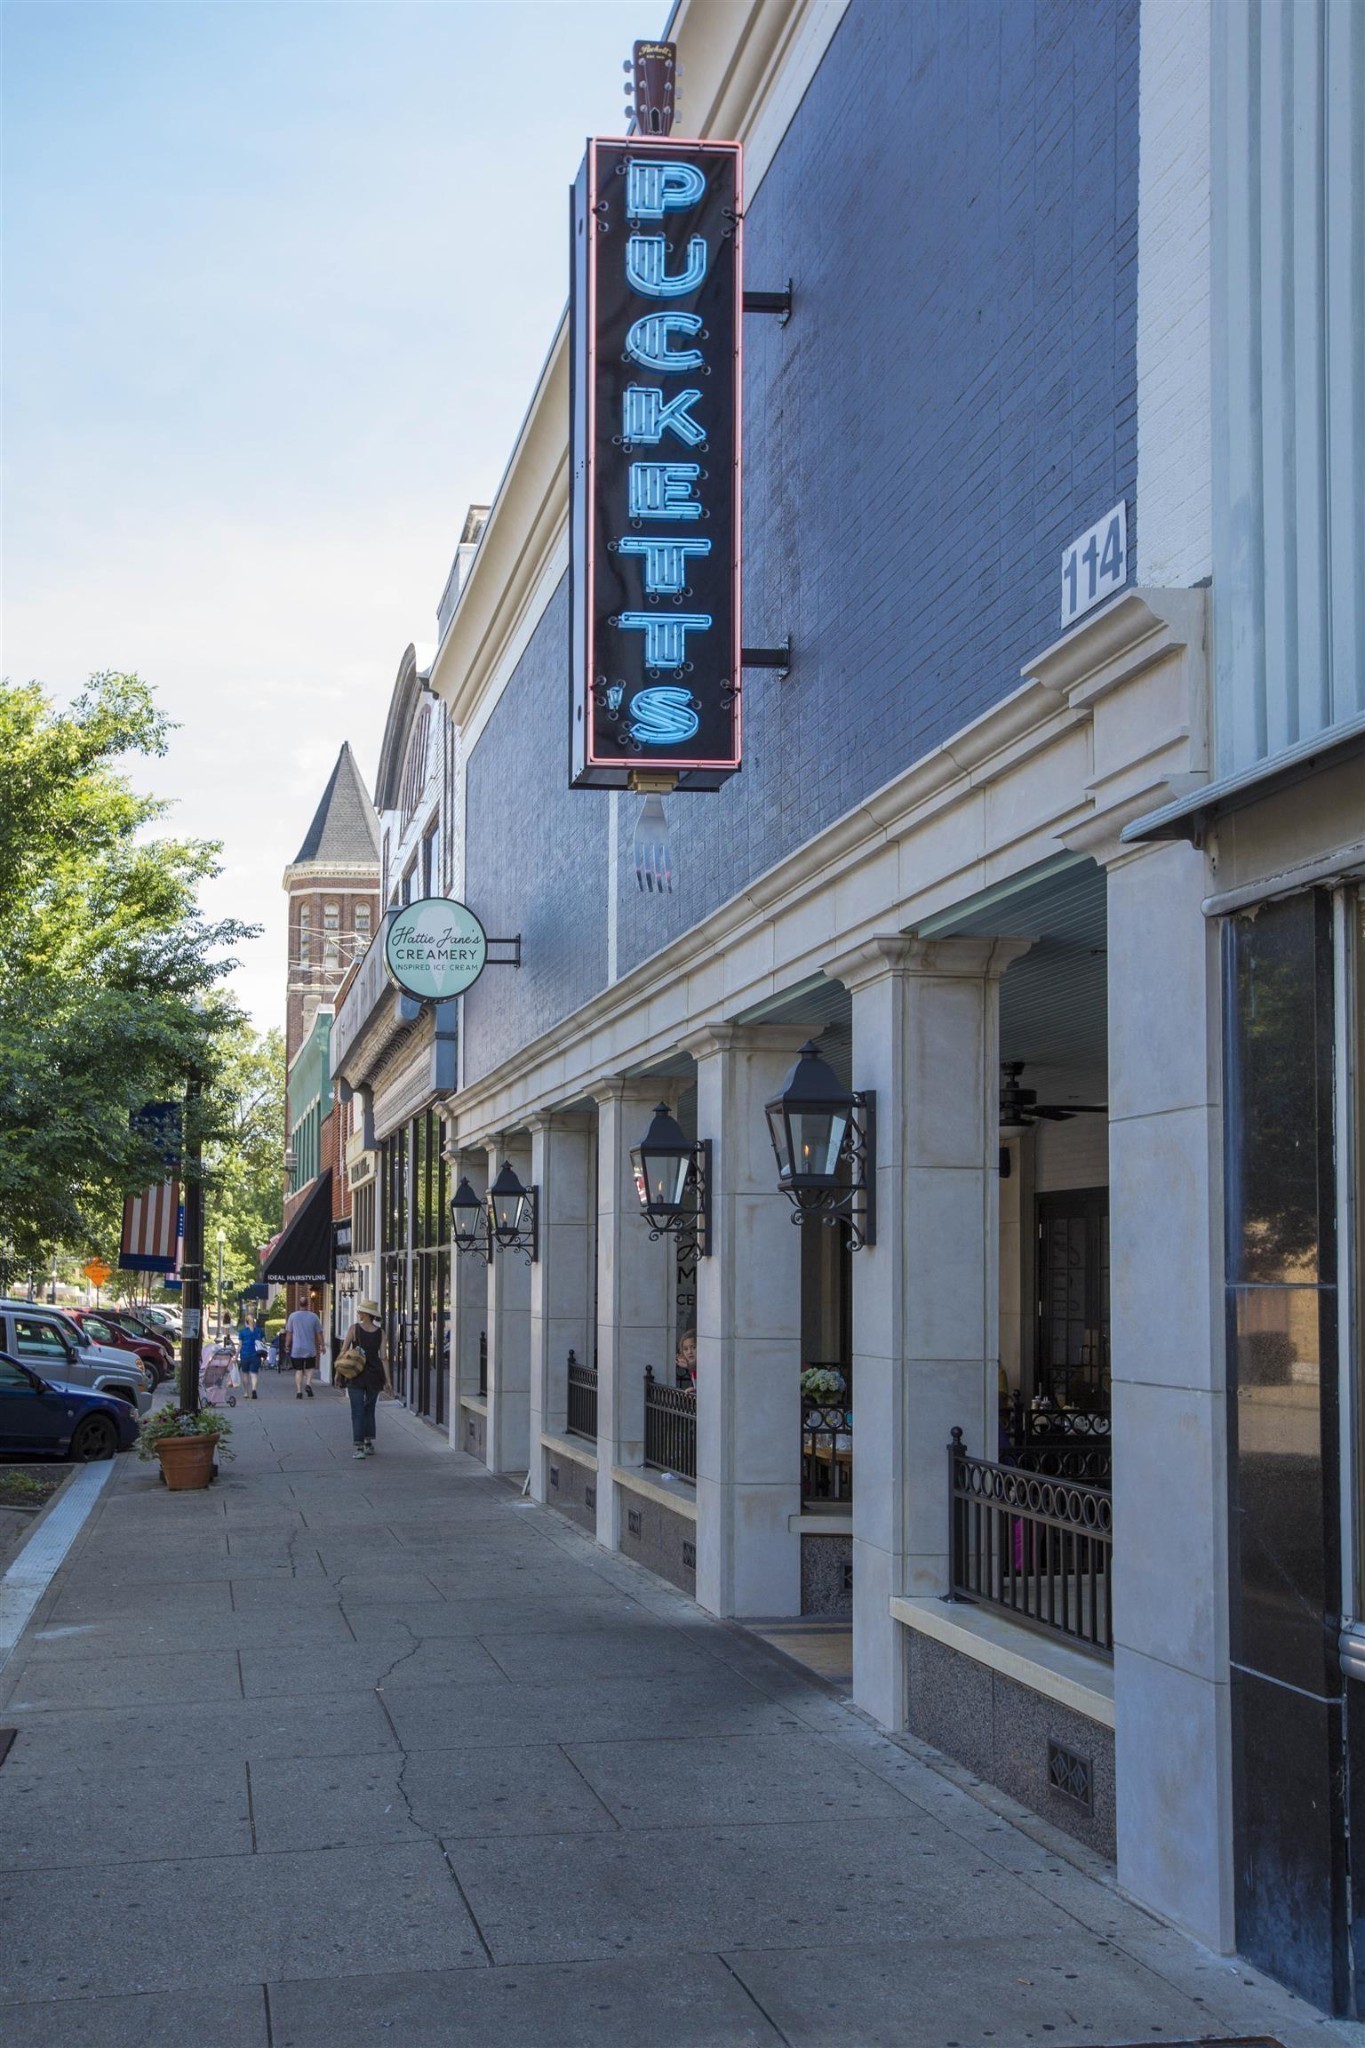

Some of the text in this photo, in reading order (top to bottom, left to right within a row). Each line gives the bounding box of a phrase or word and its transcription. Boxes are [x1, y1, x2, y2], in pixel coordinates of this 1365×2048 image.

[1064, 515, 1124, 615] 114
[391, 926, 481, 948] Hattie Jane's
[396, 949, 477, 960] CREAMERY
[395, 963, 431, 971] INSPIRED
[449, 963, 478, 971] CREAM
